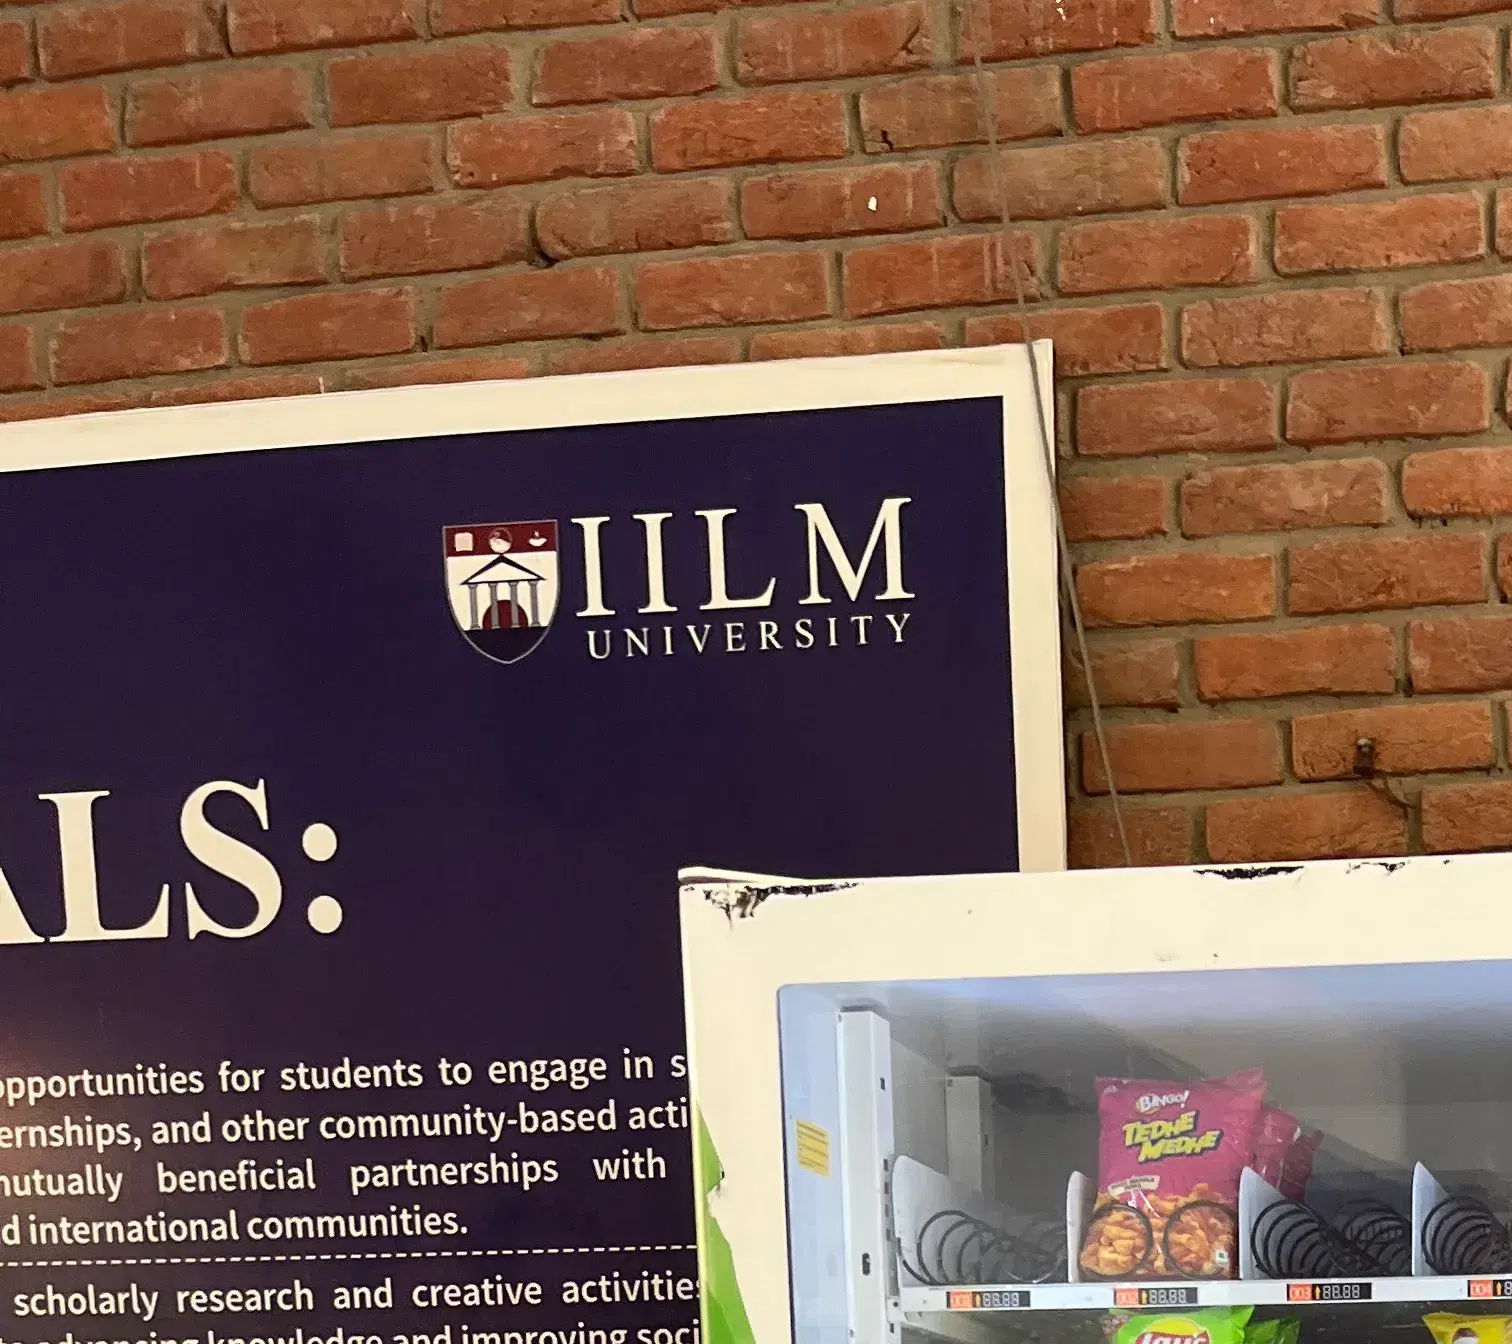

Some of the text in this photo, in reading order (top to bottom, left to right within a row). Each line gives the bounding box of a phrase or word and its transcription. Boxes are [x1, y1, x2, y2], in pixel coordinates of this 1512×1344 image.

[570, 498, 915, 616] IILM
[586, 612, 911, 659] UNIVERSITY
[0, 779, 343, 944] LS:
[218, 1061, 265, 1092] for
[281, 1057, 423, 1090] students
[488, 1058, 606, 1091] engage
[152, 1111, 211, 1144] and
[222, 1110, 309, 1142] other
[320, 1099, 616, 1142] community-based
[157, 1158, 316, 1193] beneficial
[351, 1152, 558, 1195] partnerships
[592, 1148, 666, 1180] with
[29, 1205, 467, 1244] international communities.
[14, 1283, 158, 1321] scholarly
[177, 1279, 313, 1312] research
[334, 1277, 392, 1309] and
[412, 1275, 542, 1307] creative
